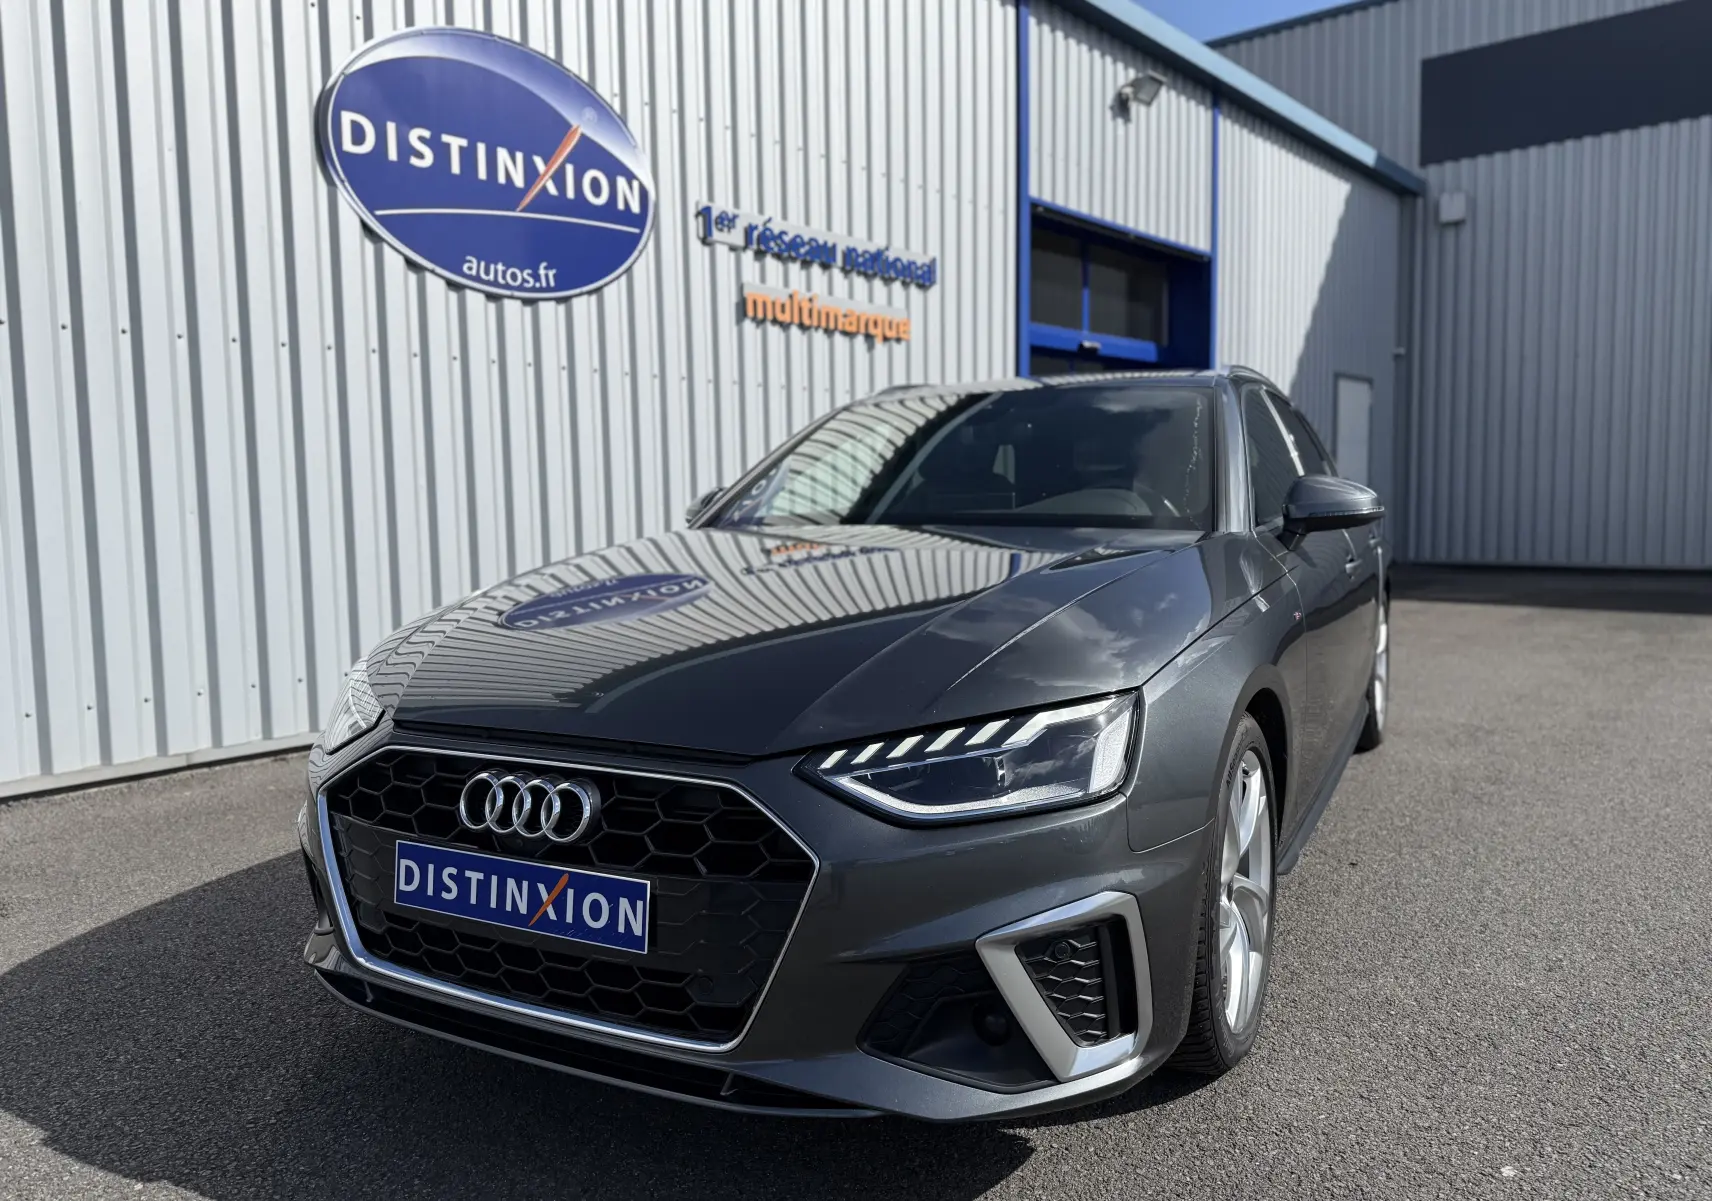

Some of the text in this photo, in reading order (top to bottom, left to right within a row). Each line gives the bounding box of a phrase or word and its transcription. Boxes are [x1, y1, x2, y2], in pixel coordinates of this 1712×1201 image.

[340, 110, 641, 214] DISTINXION
[462, 255, 557, 288] autos.fr
[696, 206, 937, 286] 1er réseau national
[745, 290, 911, 343] multimarque
[398, 858, 644, 937] DISTINXION
